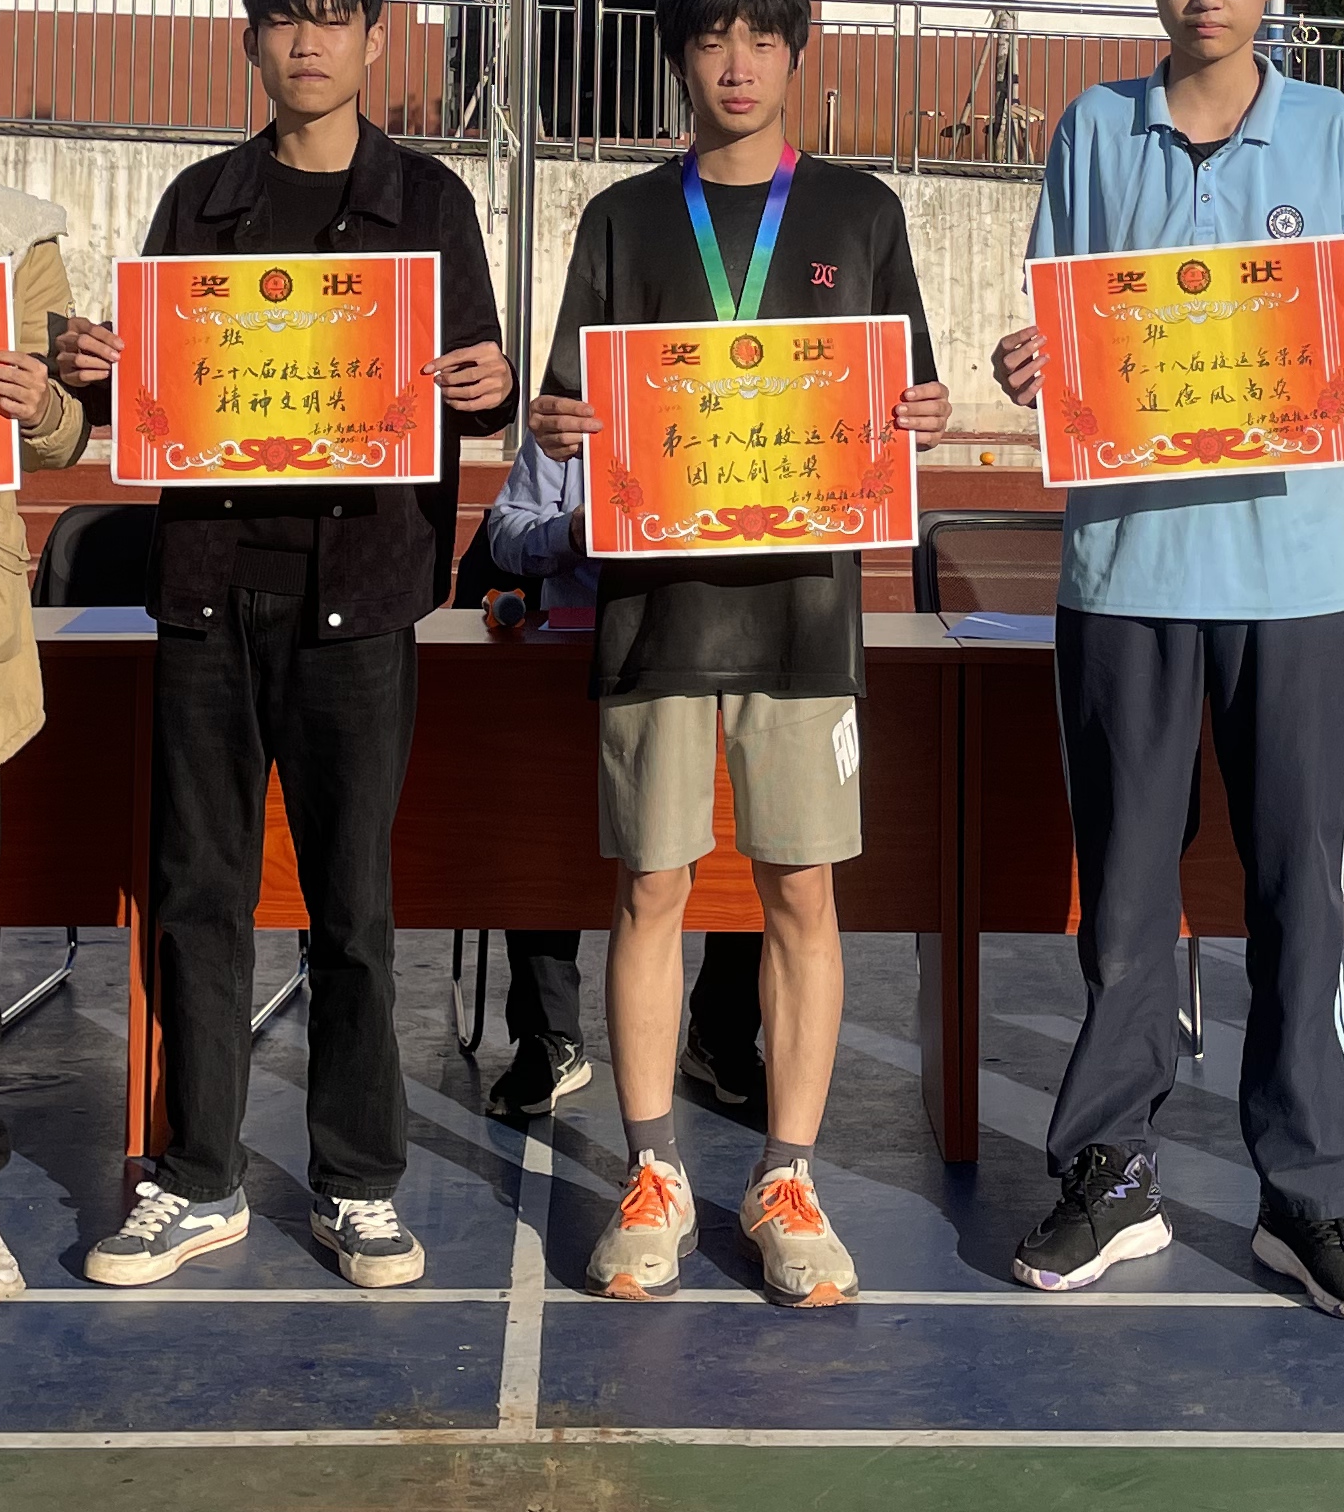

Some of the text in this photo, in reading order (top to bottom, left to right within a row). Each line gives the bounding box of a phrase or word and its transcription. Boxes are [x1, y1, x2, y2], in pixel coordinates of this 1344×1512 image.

[219, 328, 244, 351] 班
[1142, 324, 1169, 349] 班
[215, 386, 346, 418] 精神文明奖
[699, 393, 724, 419] 班
[1136, 377, 1292, 413] 道德风尚奖
[687, 454, 822, 487] 团队创意奖
